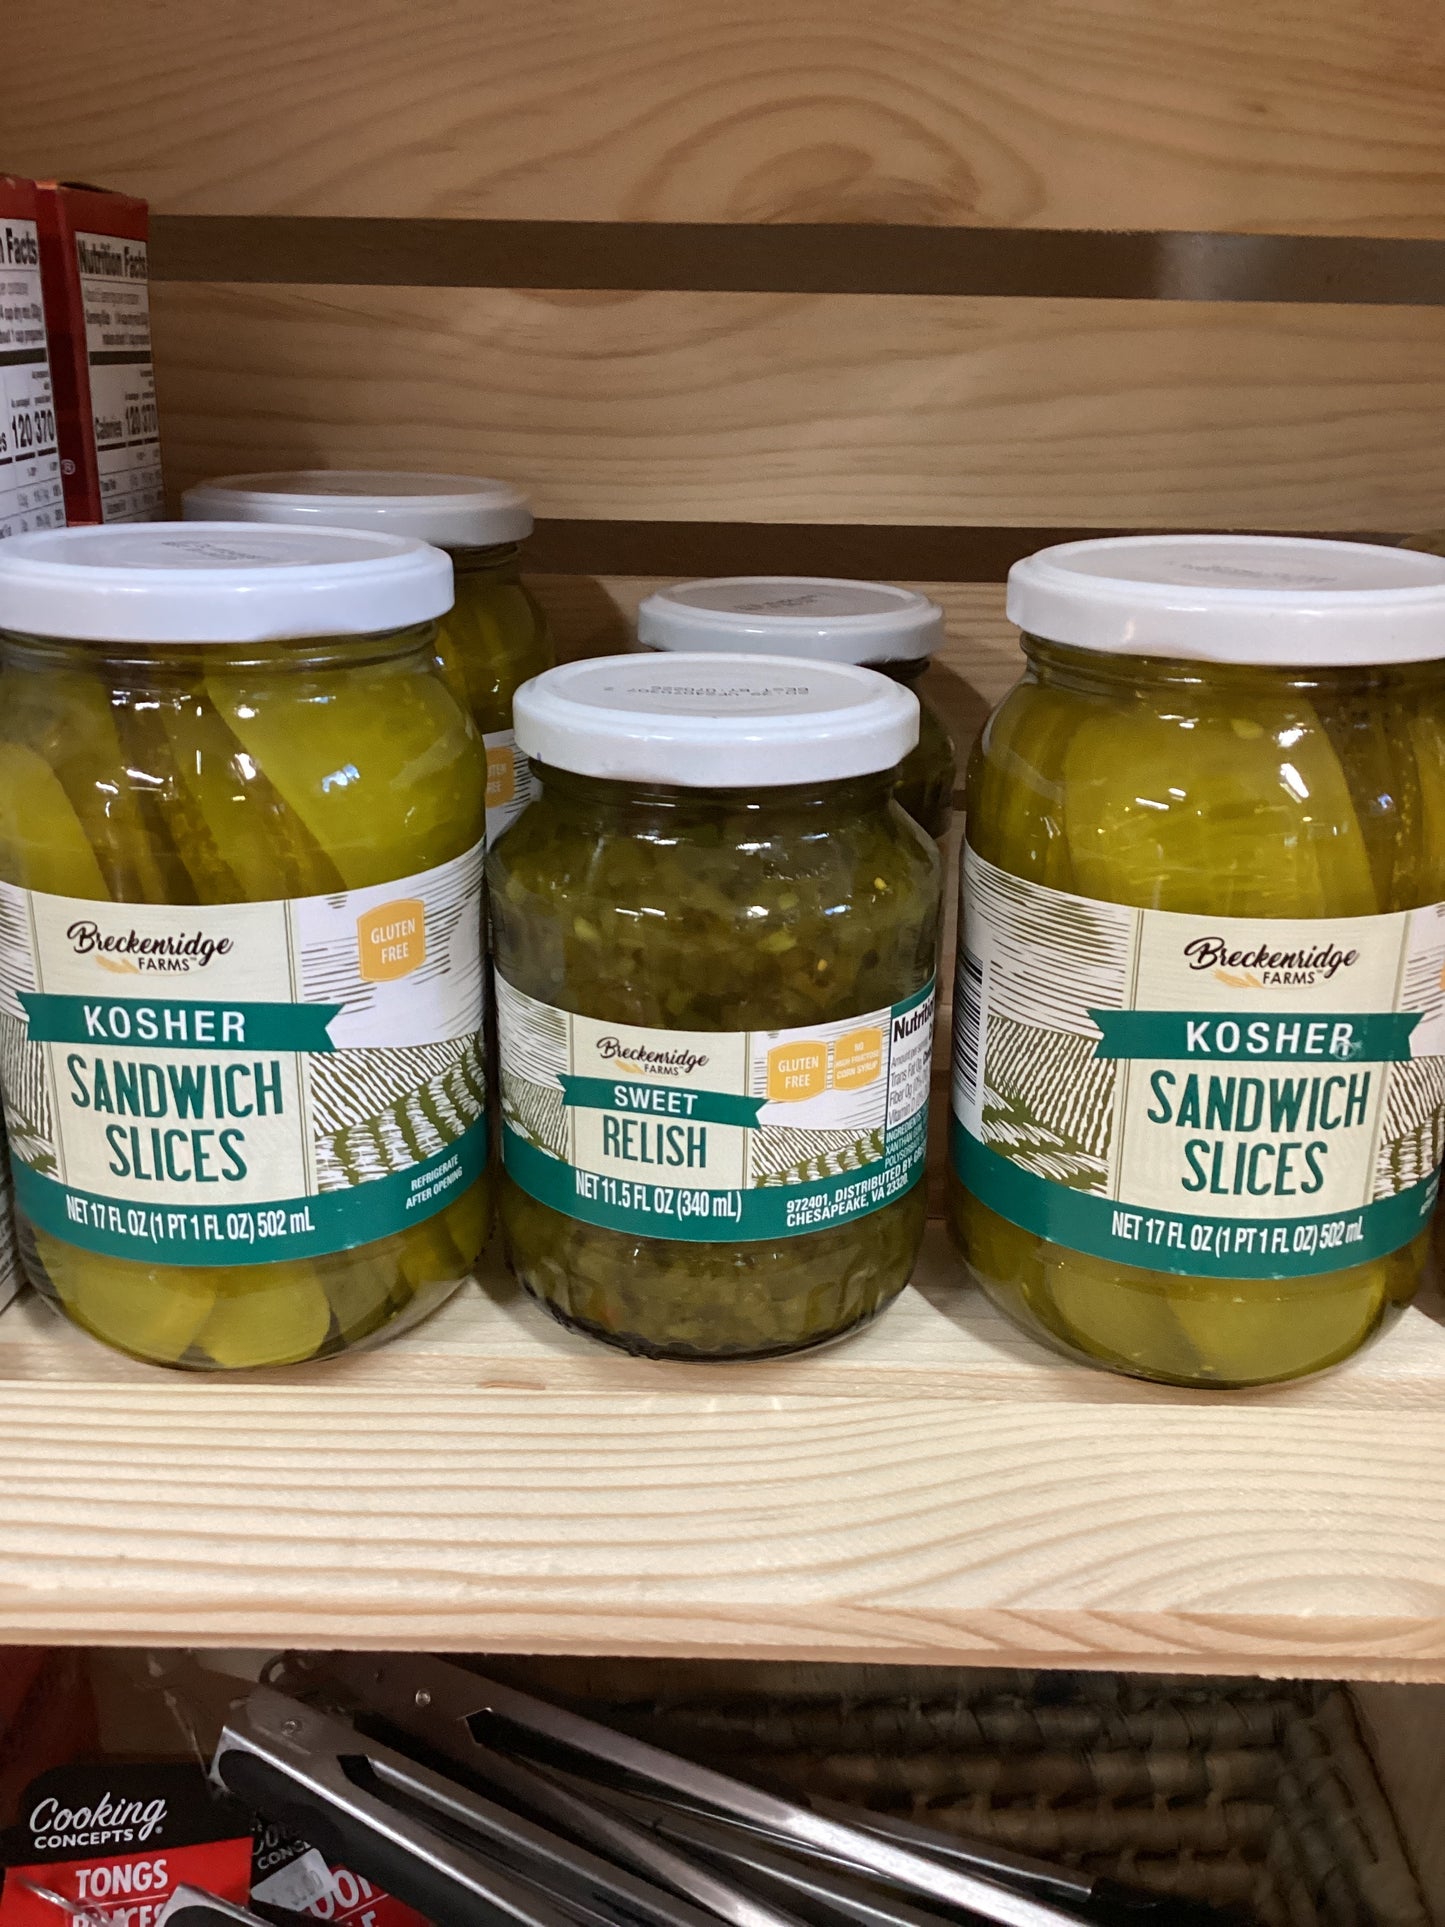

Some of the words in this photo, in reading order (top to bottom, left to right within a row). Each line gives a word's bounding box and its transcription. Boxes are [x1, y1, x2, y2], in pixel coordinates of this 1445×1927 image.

[5, 227, 38, 265] Facts
[12, 413, 33, 449] 120
[34, 409, 55, 445] 370
[66, 920, 234, 967] Breckenridge
[371, 918, 416, 944] GLUTEN
[381, 942, 409, 965] FREE
[1184, 936, 1360, 979] Breckenridge
[84, 1005, 247, 1043] KOSHER
[1186, 1021, 1354, 1056] KOSHER
[596, 1036, 710, 1074] Breckenridge
[778, 1055, 819, 1073] GLUTEN
[66, 1053, 284, 1120] SANDWICH
[614, 1085, 698, 1115] SWEET
[785, 1074, 811, 1088] FREE
[1147, 1069, 1371, 1133] SANDWICH
[105, 1124, 248, 1183] SLICES
[603, 1115, 707, 1168] RELISH
[411, 1154, 458, 1191] REFRIGERATE
[834, 1164, 901, 1204] DISTRIBUTED
[1181, 1139, 1328, 1196] SLICES
[406, 1187, 432, 1210] AFTER
[433, 1166, 463, 1195] OPENING
[576, 1169, 599, 1200] NET
[602, 1178, 630, 1208] 11.5
[634, 1184, 650, 1211] FL
[654, 1187, 674, 1214] OZ
[677, 1190, 709, 1221] (340
[712, 1191, 742, 1223] mL)
[786, 1195, 869, 1228] CHESAPEAKE,
[871, 1187, 885, 1203] VA
[66, 1194, 89, 1225] NET
[90, 1202, 106, 1229] 17
[108, 1207, 126, 1234] FL
[127, 1209, 148, 1237] OZ
[151, 1211, 164, 1244] (1
[168, 1214, 187, 1240] PT
[190, 1214, 201, 1240] 1
[204, 1214, 224, 1241] FL
[226, 1211, 255, 1244] OZ)
[257, 1209, 287, 1238] 502
[290, 1205, 315, 1234] mL
[1112, 1210, 1143, 1241] NET
[1145, 1217, 1165, 1246] 17
[1167, 1221, 1186, 1249] FL
[1190, 1224, 1214, 1252] OZ
[1215, 1225, 1231, 1258] (1
[1234, 1228, 1258, 1253] PT
[1259, 1227, 1268, 1253] 1
[1271, 1227, 1289, 1253] FL
[1293, 1225, 1318, 1256] OZ)
[1319, 1220, 1345, 1249] 502
[1345, 1215, 1364, 1244] mL
[29, 1792, 167, 1841] Cooking
[34, 1828, 134, 1849] CONCEPTS
[75, 1859, 168, 1898] TONGS
